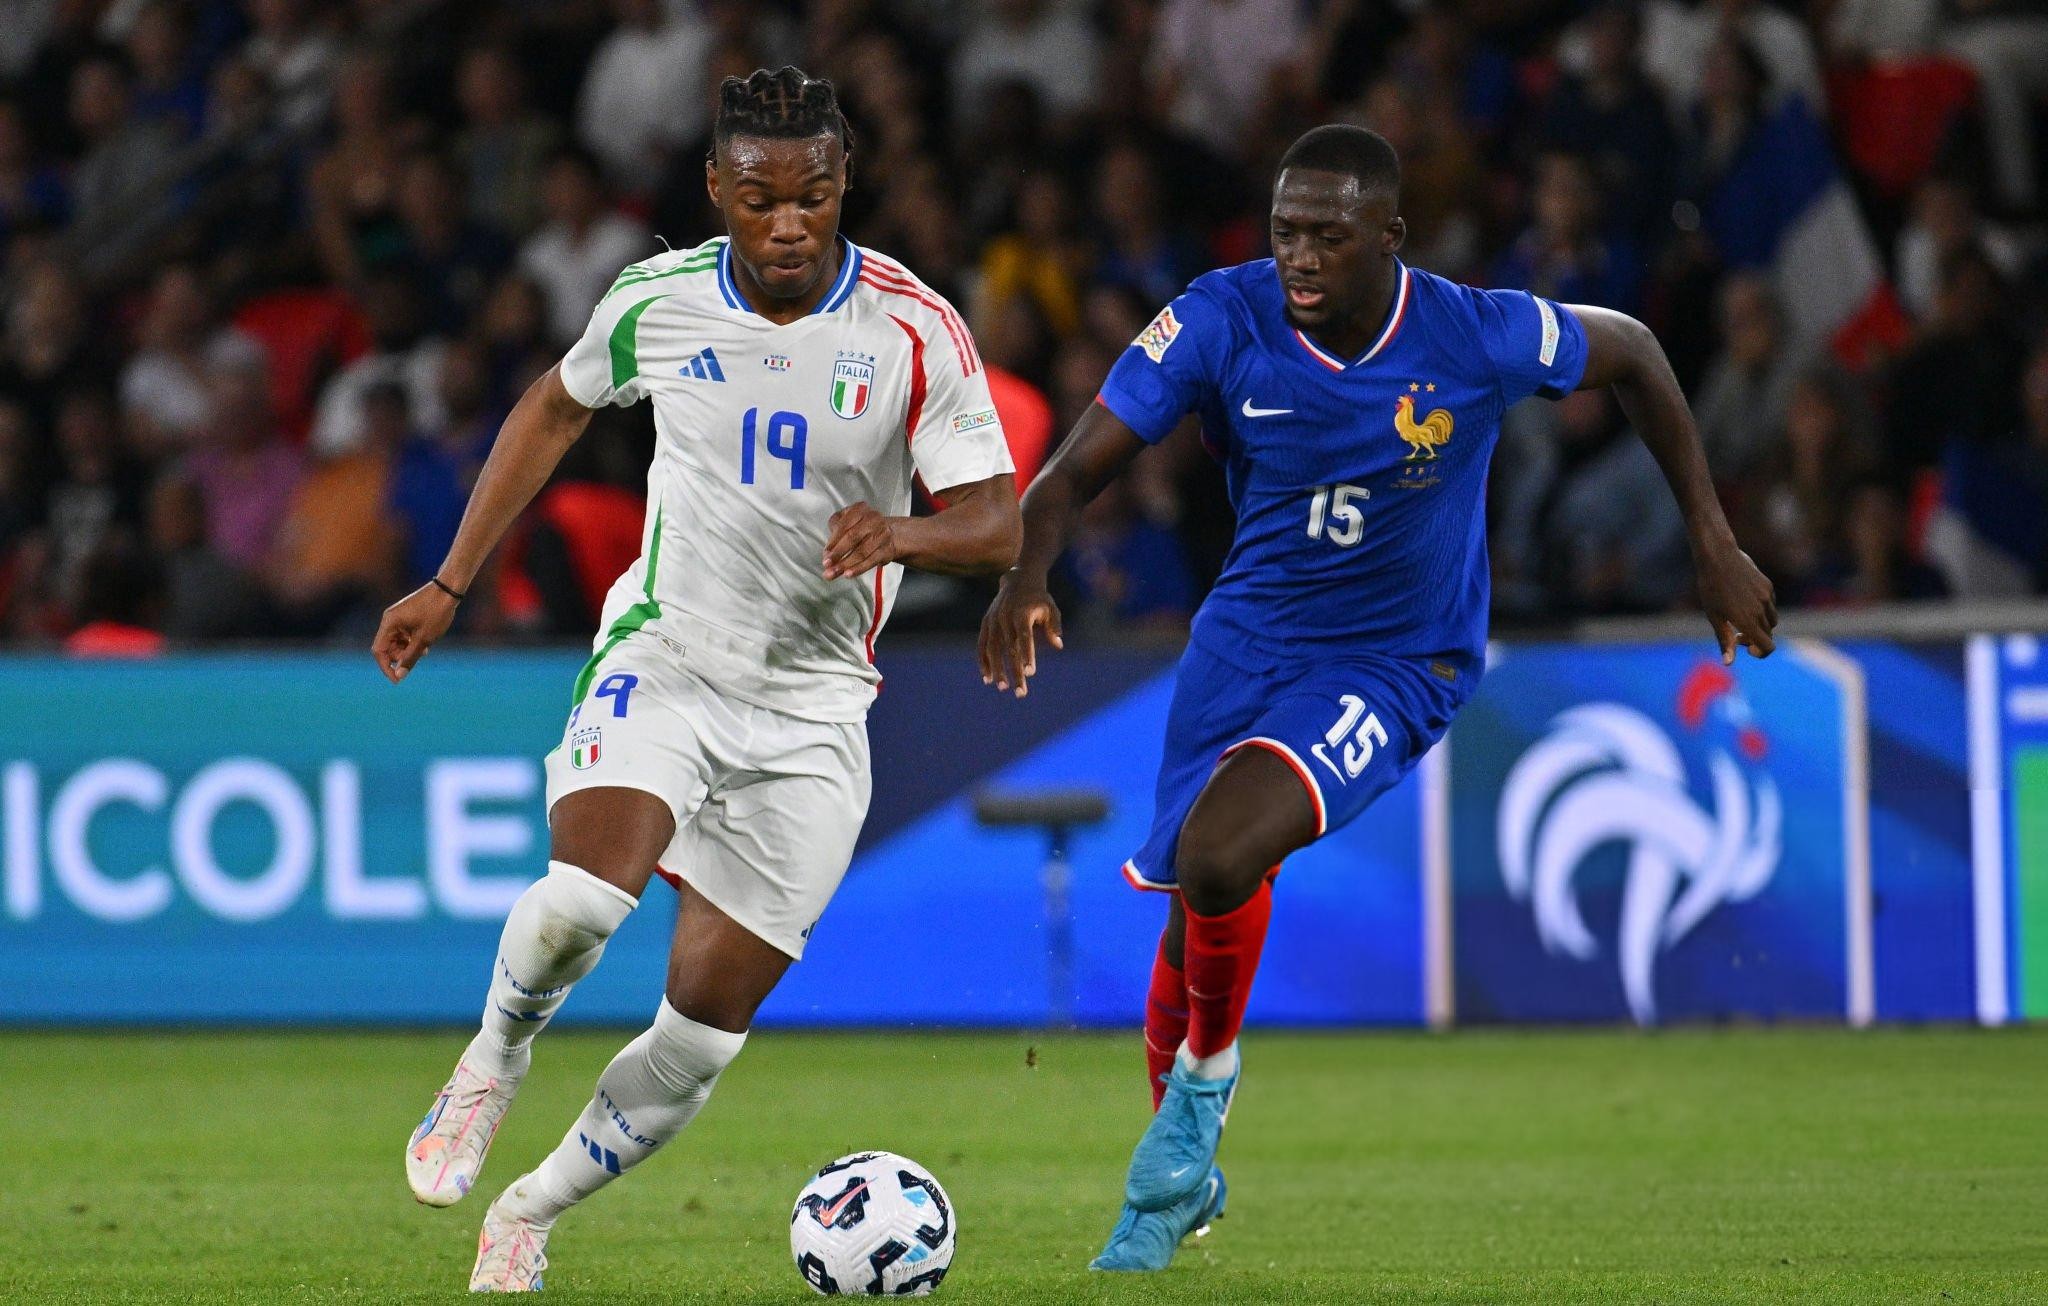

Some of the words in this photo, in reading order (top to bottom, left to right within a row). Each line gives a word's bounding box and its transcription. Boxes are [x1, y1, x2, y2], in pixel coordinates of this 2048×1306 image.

[837, 364, 869, 379] ITALIA
[740, 407, 808, 489] 19
[1306, 484, 1371, 548] 15
[574, 734, 598, 747] ITALIA
[1324, 694, 1388, 779] 15
[3, 757, 541, 922] ICOLE
[600, 1089, 657, 1147] ITALIA
